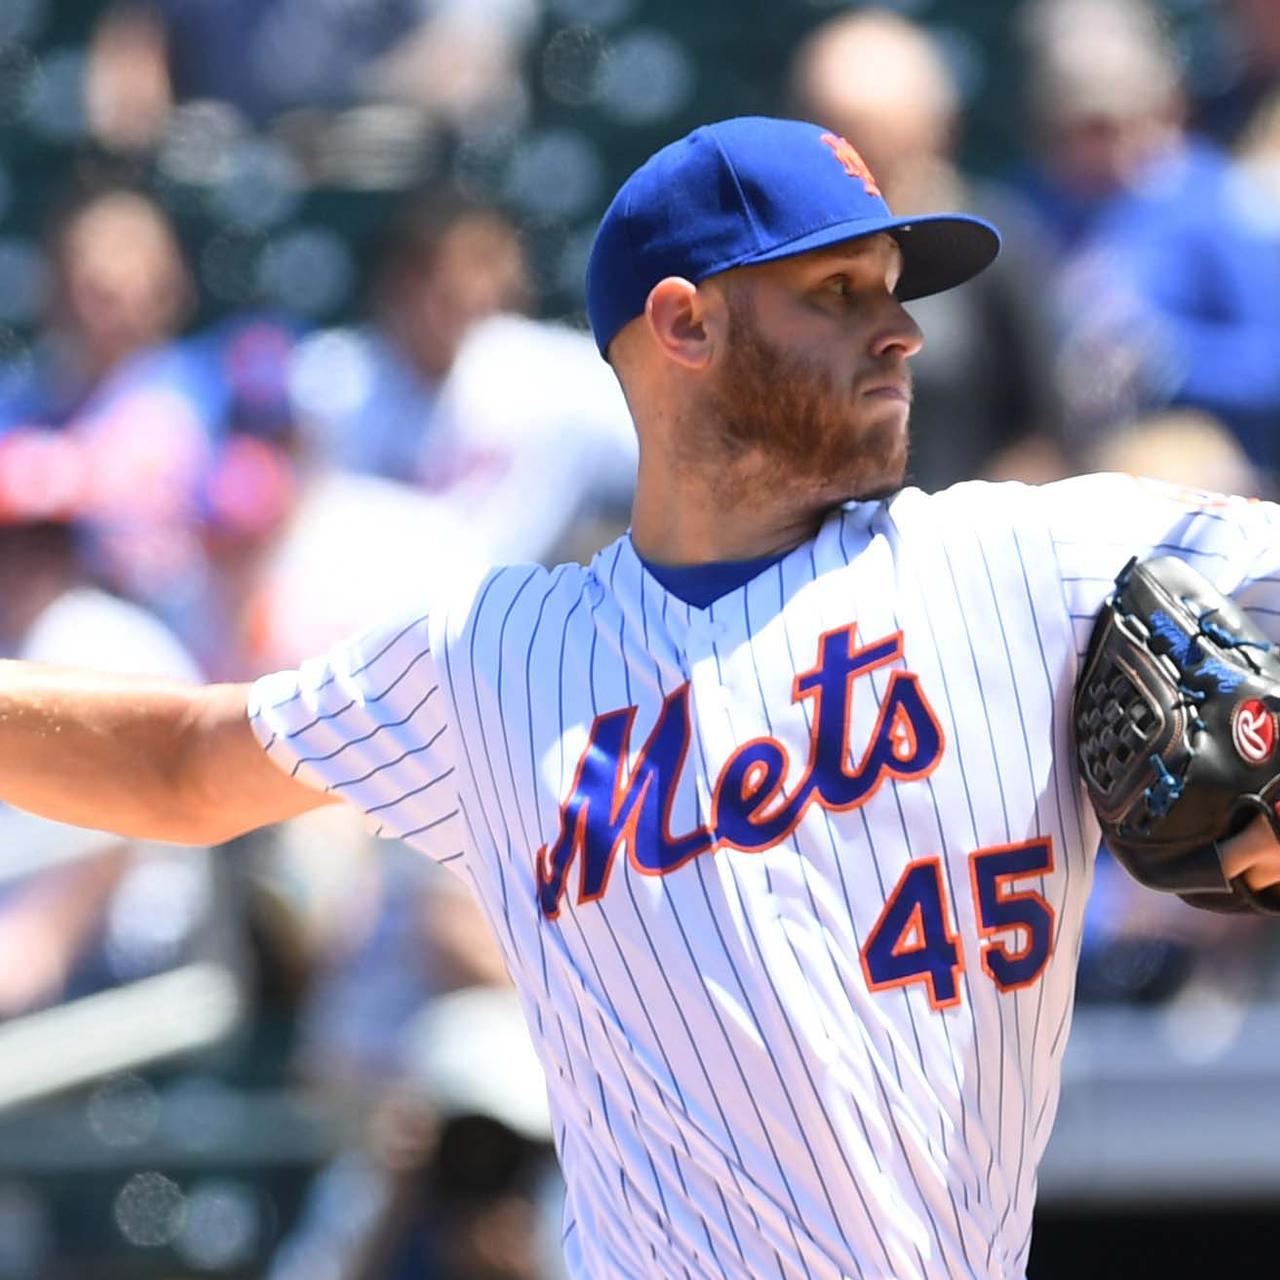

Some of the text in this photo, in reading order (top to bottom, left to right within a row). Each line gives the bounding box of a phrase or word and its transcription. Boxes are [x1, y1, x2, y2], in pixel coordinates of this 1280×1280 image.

[536, 622, 945, 920] Mets
[1238, 709, 1269, 760] R
[860, 835, 1055, 1010] 45
